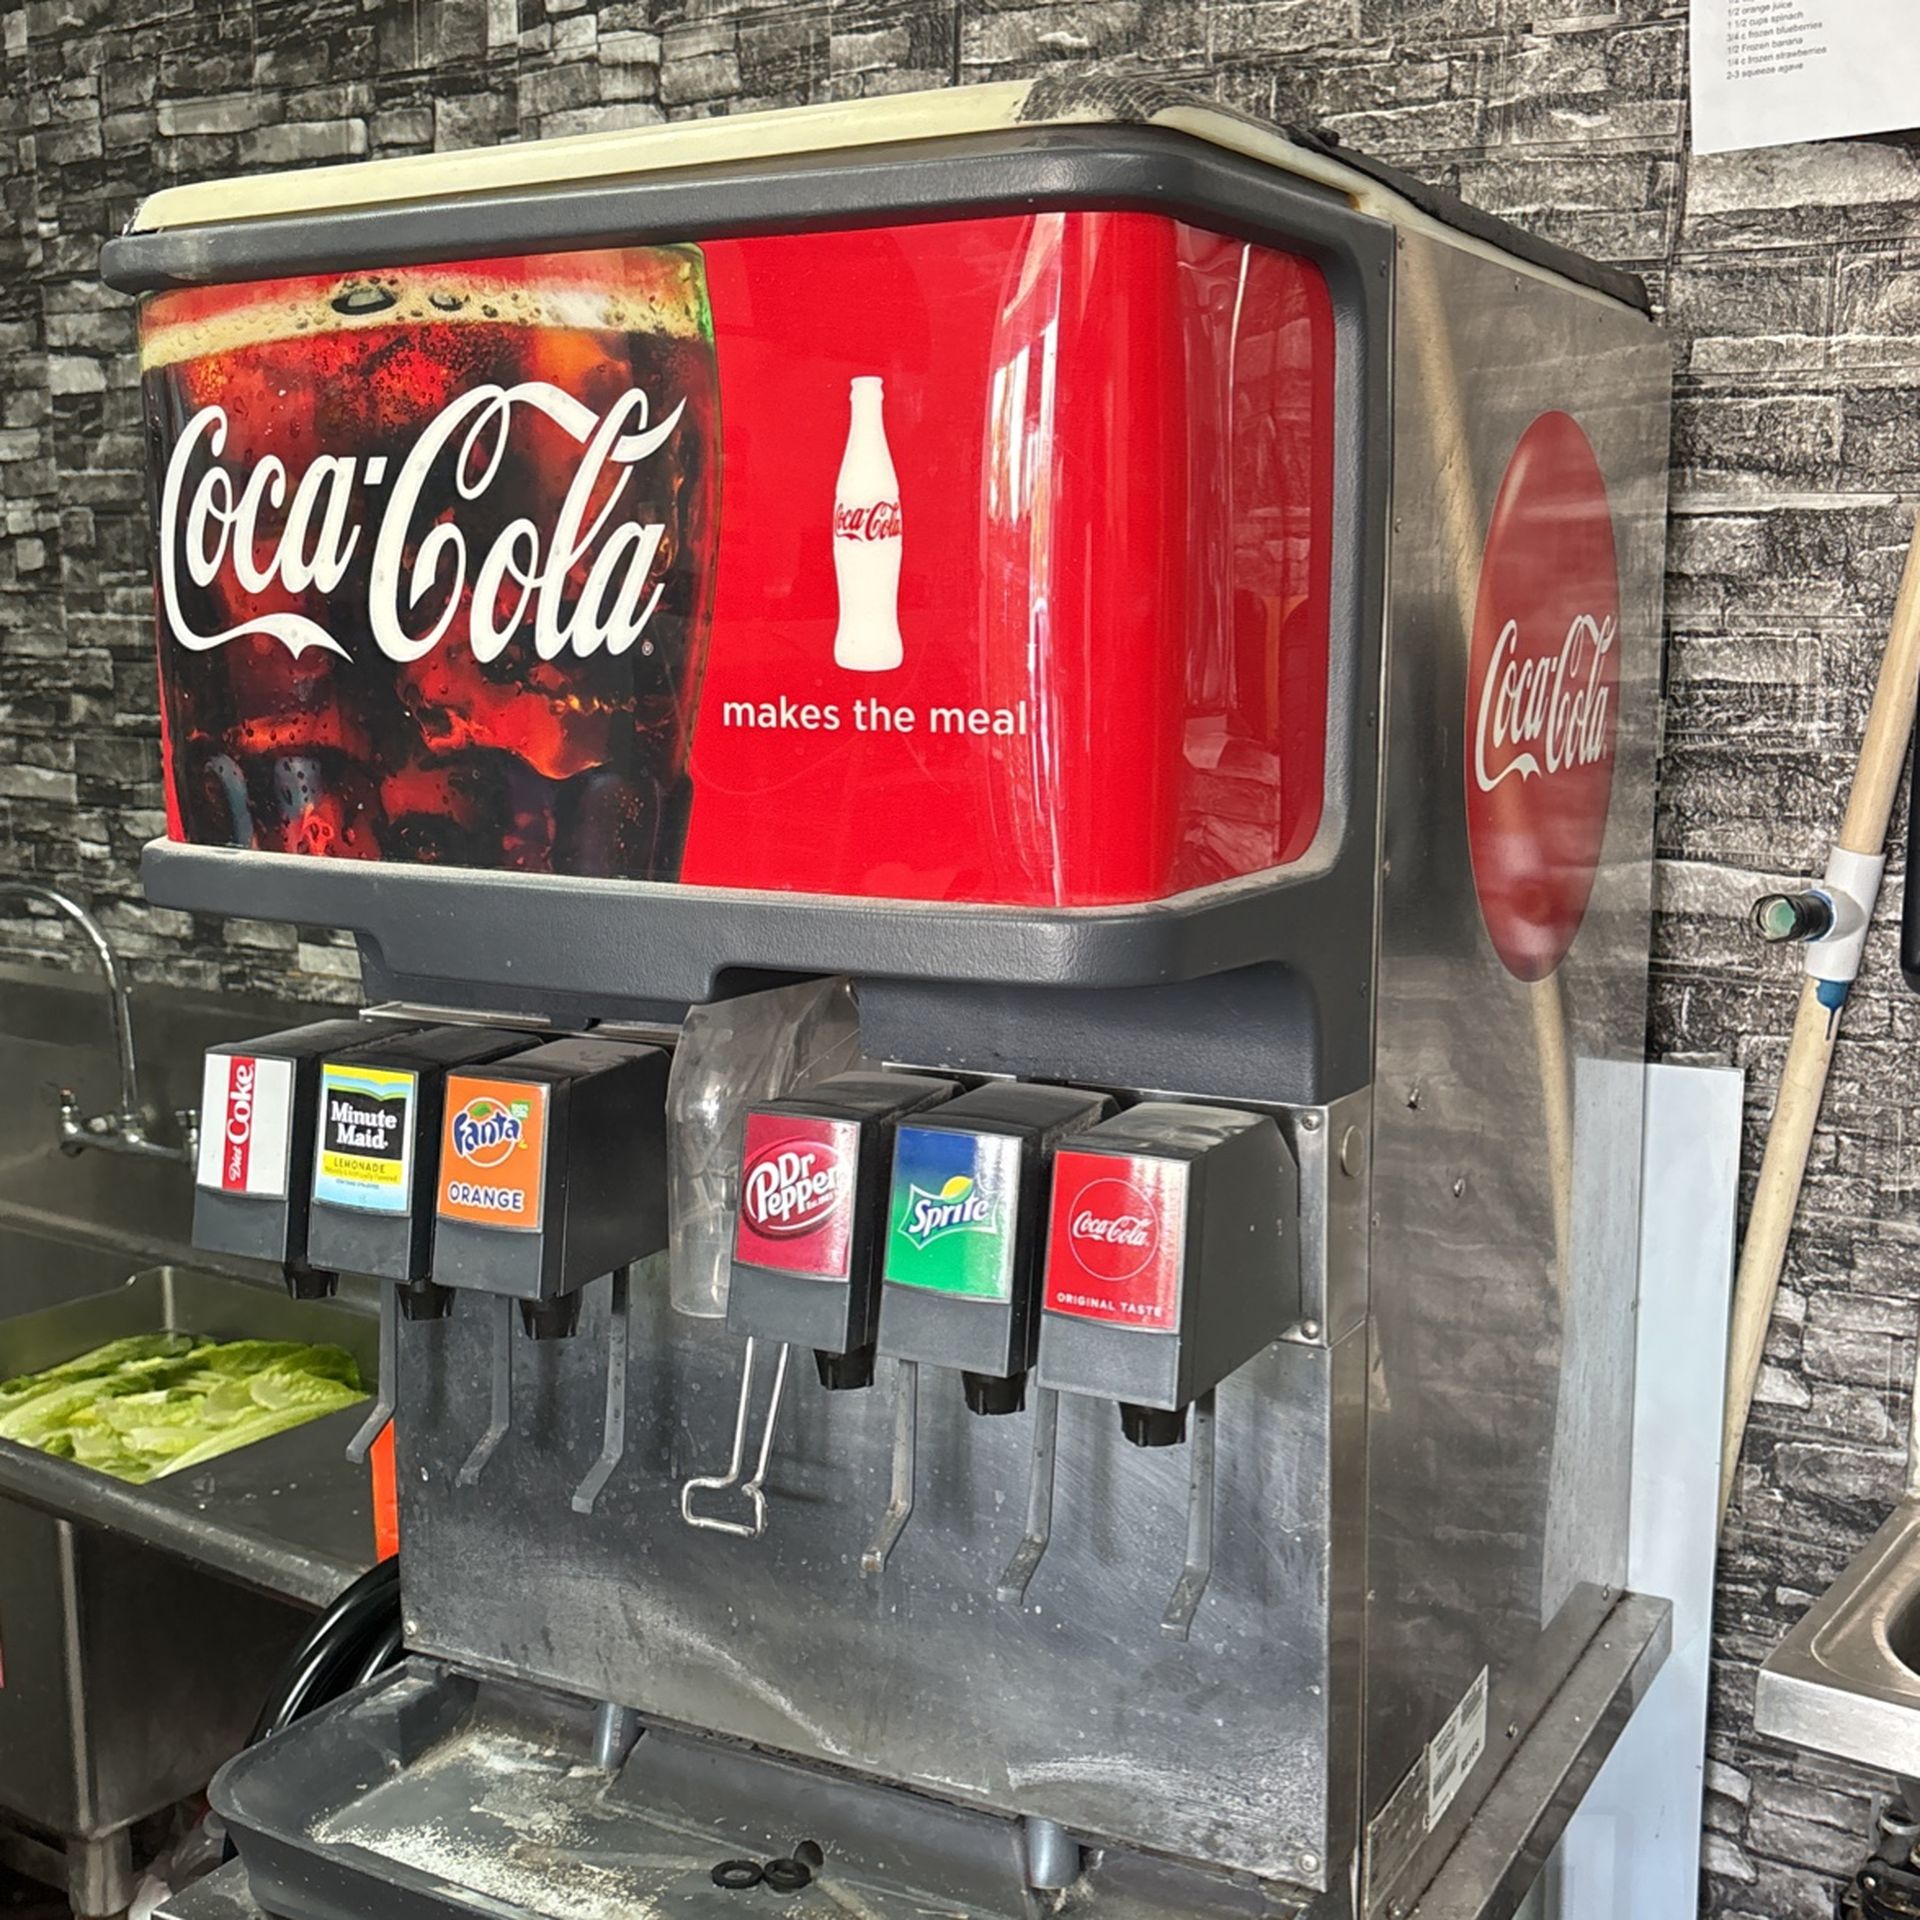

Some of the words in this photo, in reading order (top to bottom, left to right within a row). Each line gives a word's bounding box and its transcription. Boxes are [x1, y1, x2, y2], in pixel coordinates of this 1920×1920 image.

[1741, 4, 1770, 15] orange
[1772, 1, 1793, 11] juice
[1748, 17, 1768, 26] cups
[1771, 11, 1804, 23] spinach
[1748, 29, 1774, 39] frozen
[1776, 22, 1823, 35] blueberries
[1771, 37, 1804, 48] banana
[1741, 66, 1776, 78] squeeze
[1777, 62, 1804, 74] agave
[1748, 54, 1774, 64] frozen
[1775, 46, 1827, 60] strawberries
[160, 381, 687, 664] Coca-Cola
[722, 695, 841, 730] makes
[852, 697, 916, 733] the
[929, 700, 1027, 736] meal
[1474, 613, 1618, 793] Coca-Cola
[226, 1063, 254, 1145] Coke
[331, 1100, 398, 1129] Minute
[452, 1110, 521, 1157] Fanta
[228, 1145, 243, 1182] Diet
[333, 1157, 386, 1174] LEMONADE
[777, 1151, 816, 1189] Dr
[449, 1183, 523, 1211] ORANGE
[746, 1161, 843, 1224] Pepper
[908, 1188, 989, 1238] Sprite
[1072, 1210, 1153, 1246] Coca-Cola
[1056, 1292, 1116, 1312] ORIGINAL
[1121, 1301, 1164, 1318] TASTE
